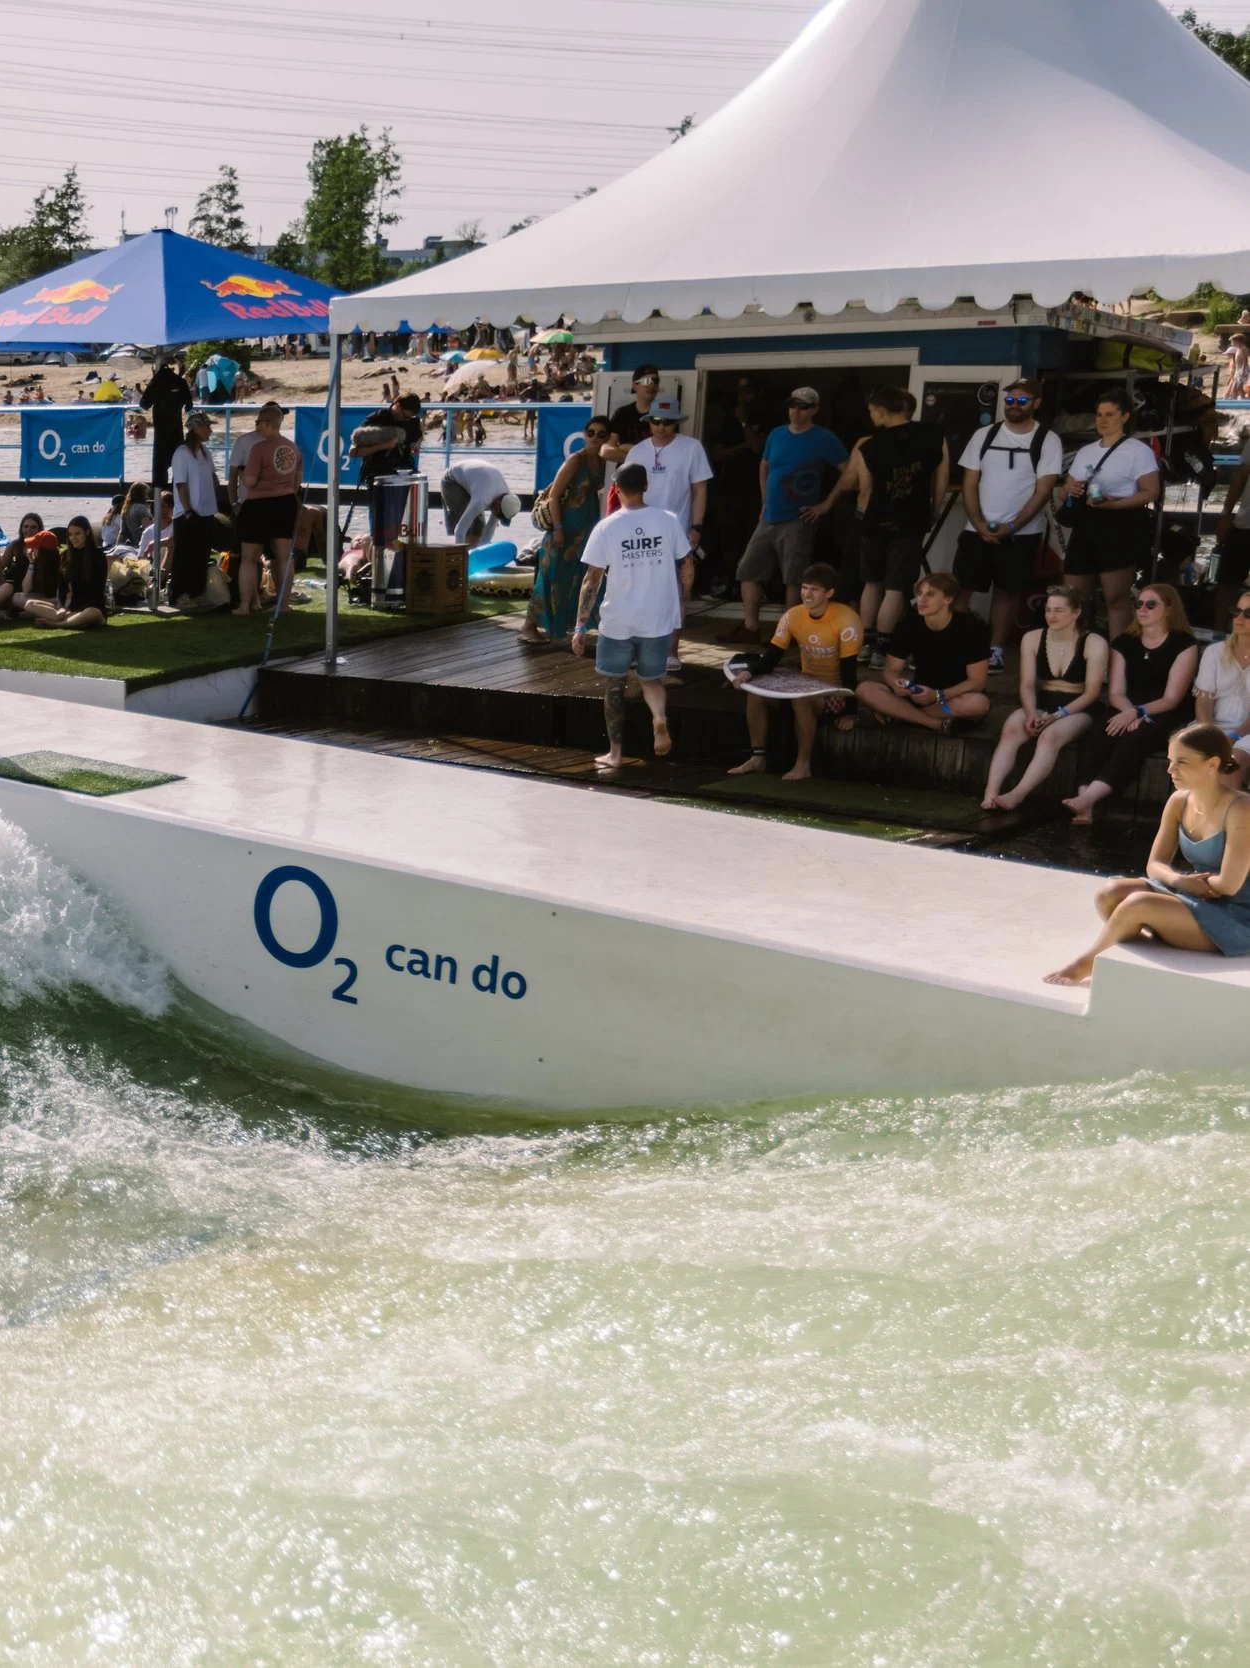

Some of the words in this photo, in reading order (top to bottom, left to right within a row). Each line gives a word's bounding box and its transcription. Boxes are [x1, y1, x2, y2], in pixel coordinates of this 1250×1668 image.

[37, 305, 108, 325] Bull
[221, 299, 293, 319] Red
[38, 429, 67, 466] O2
[71, 443, 90, 453] can
[93, 441, 105, 453] do
[621, 536, 662, 552] SURF
[622, 549, 662, 560] MASTERS
[253, 864, 359, 1005] O2
[385, 943, 457, 984] can
[471, 954, 528, 1000] do
